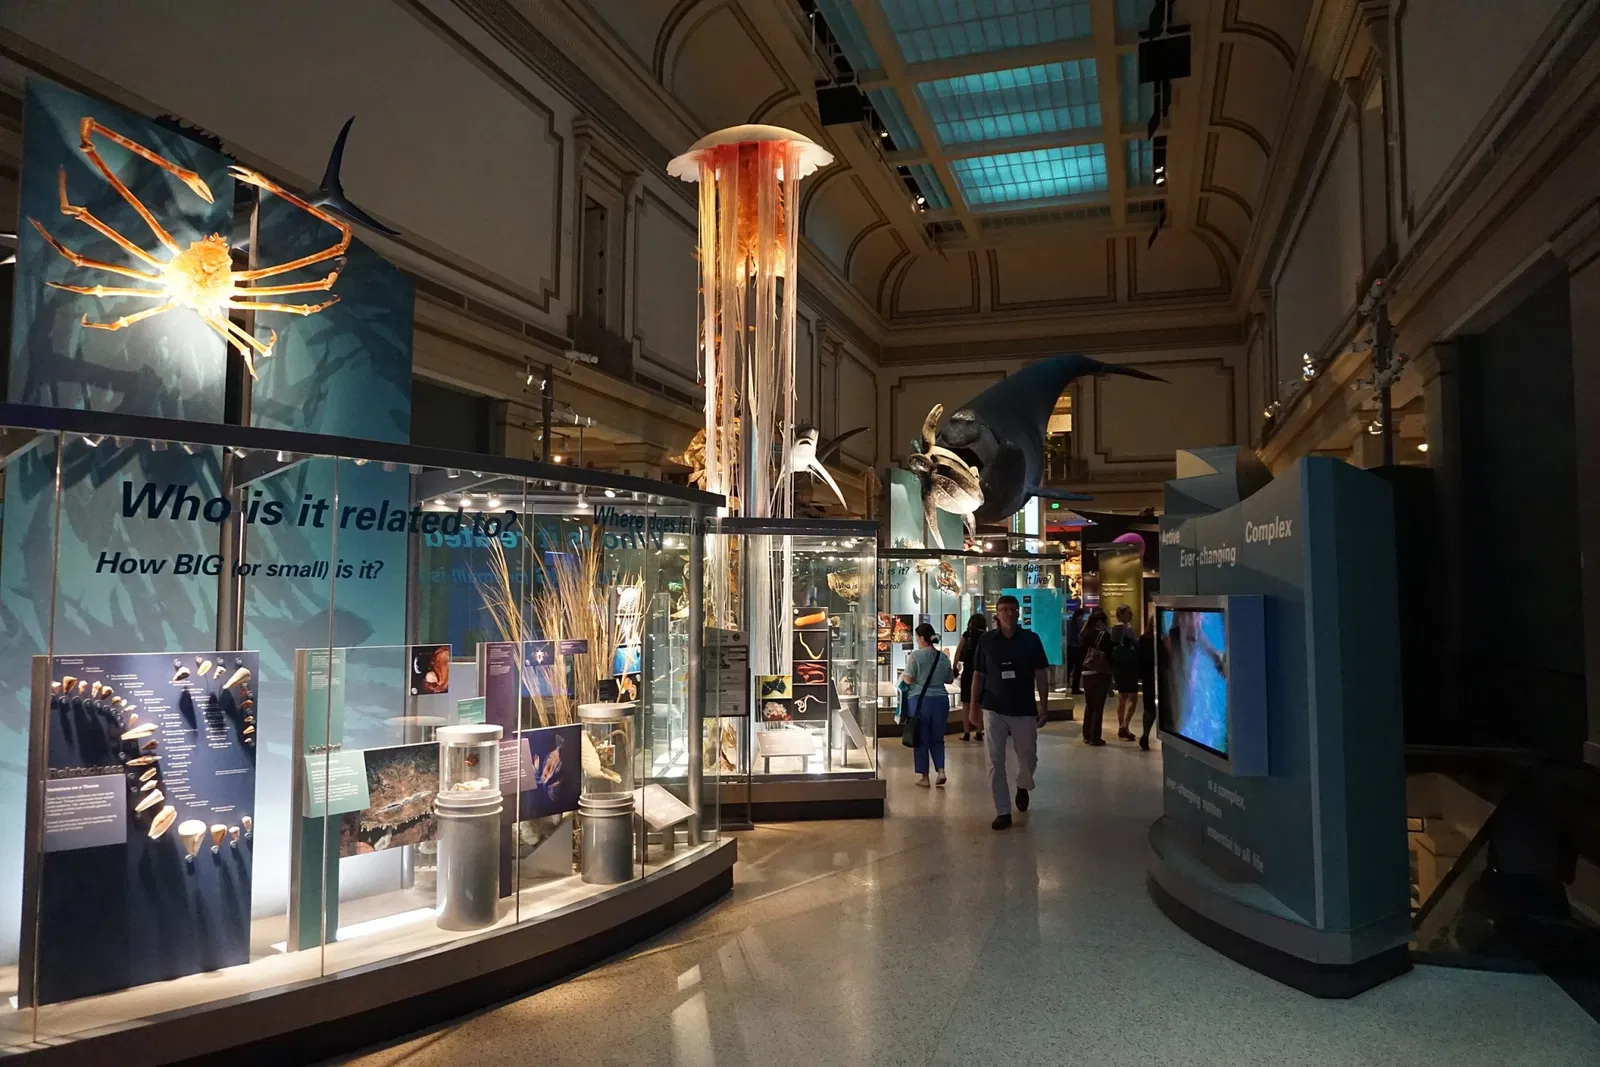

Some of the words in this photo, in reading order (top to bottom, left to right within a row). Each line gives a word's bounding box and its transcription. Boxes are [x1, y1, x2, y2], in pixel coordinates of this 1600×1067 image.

[122, 481, 232, 523] Who
[246, 490, 284, 526] is
[298, 494, 329, 528] it
[339, 499, 463, 536] related
[472, 509, 518, 538] to?
[593, 504, 647, 530] Where
[648, 512, 677, 533] does
[1161, 528, 1180, 546] Active
[1245, 516, 1293, 546] Complex
[95, 551, 167, 575] How
[173, 553, 225, 576] BIG
[231, 560, 262, 579] (or
[266, 561, 330, 580] small)
[335, 559, 353, 578] is
[358, 560, 385, 580] it?
[1023, 561, 1043, 573] does
[1180, 543, 1237, 568] Ever-changing
[898, 566, 910, 575] it?
[48, 764, 124, 779] Relatedness
